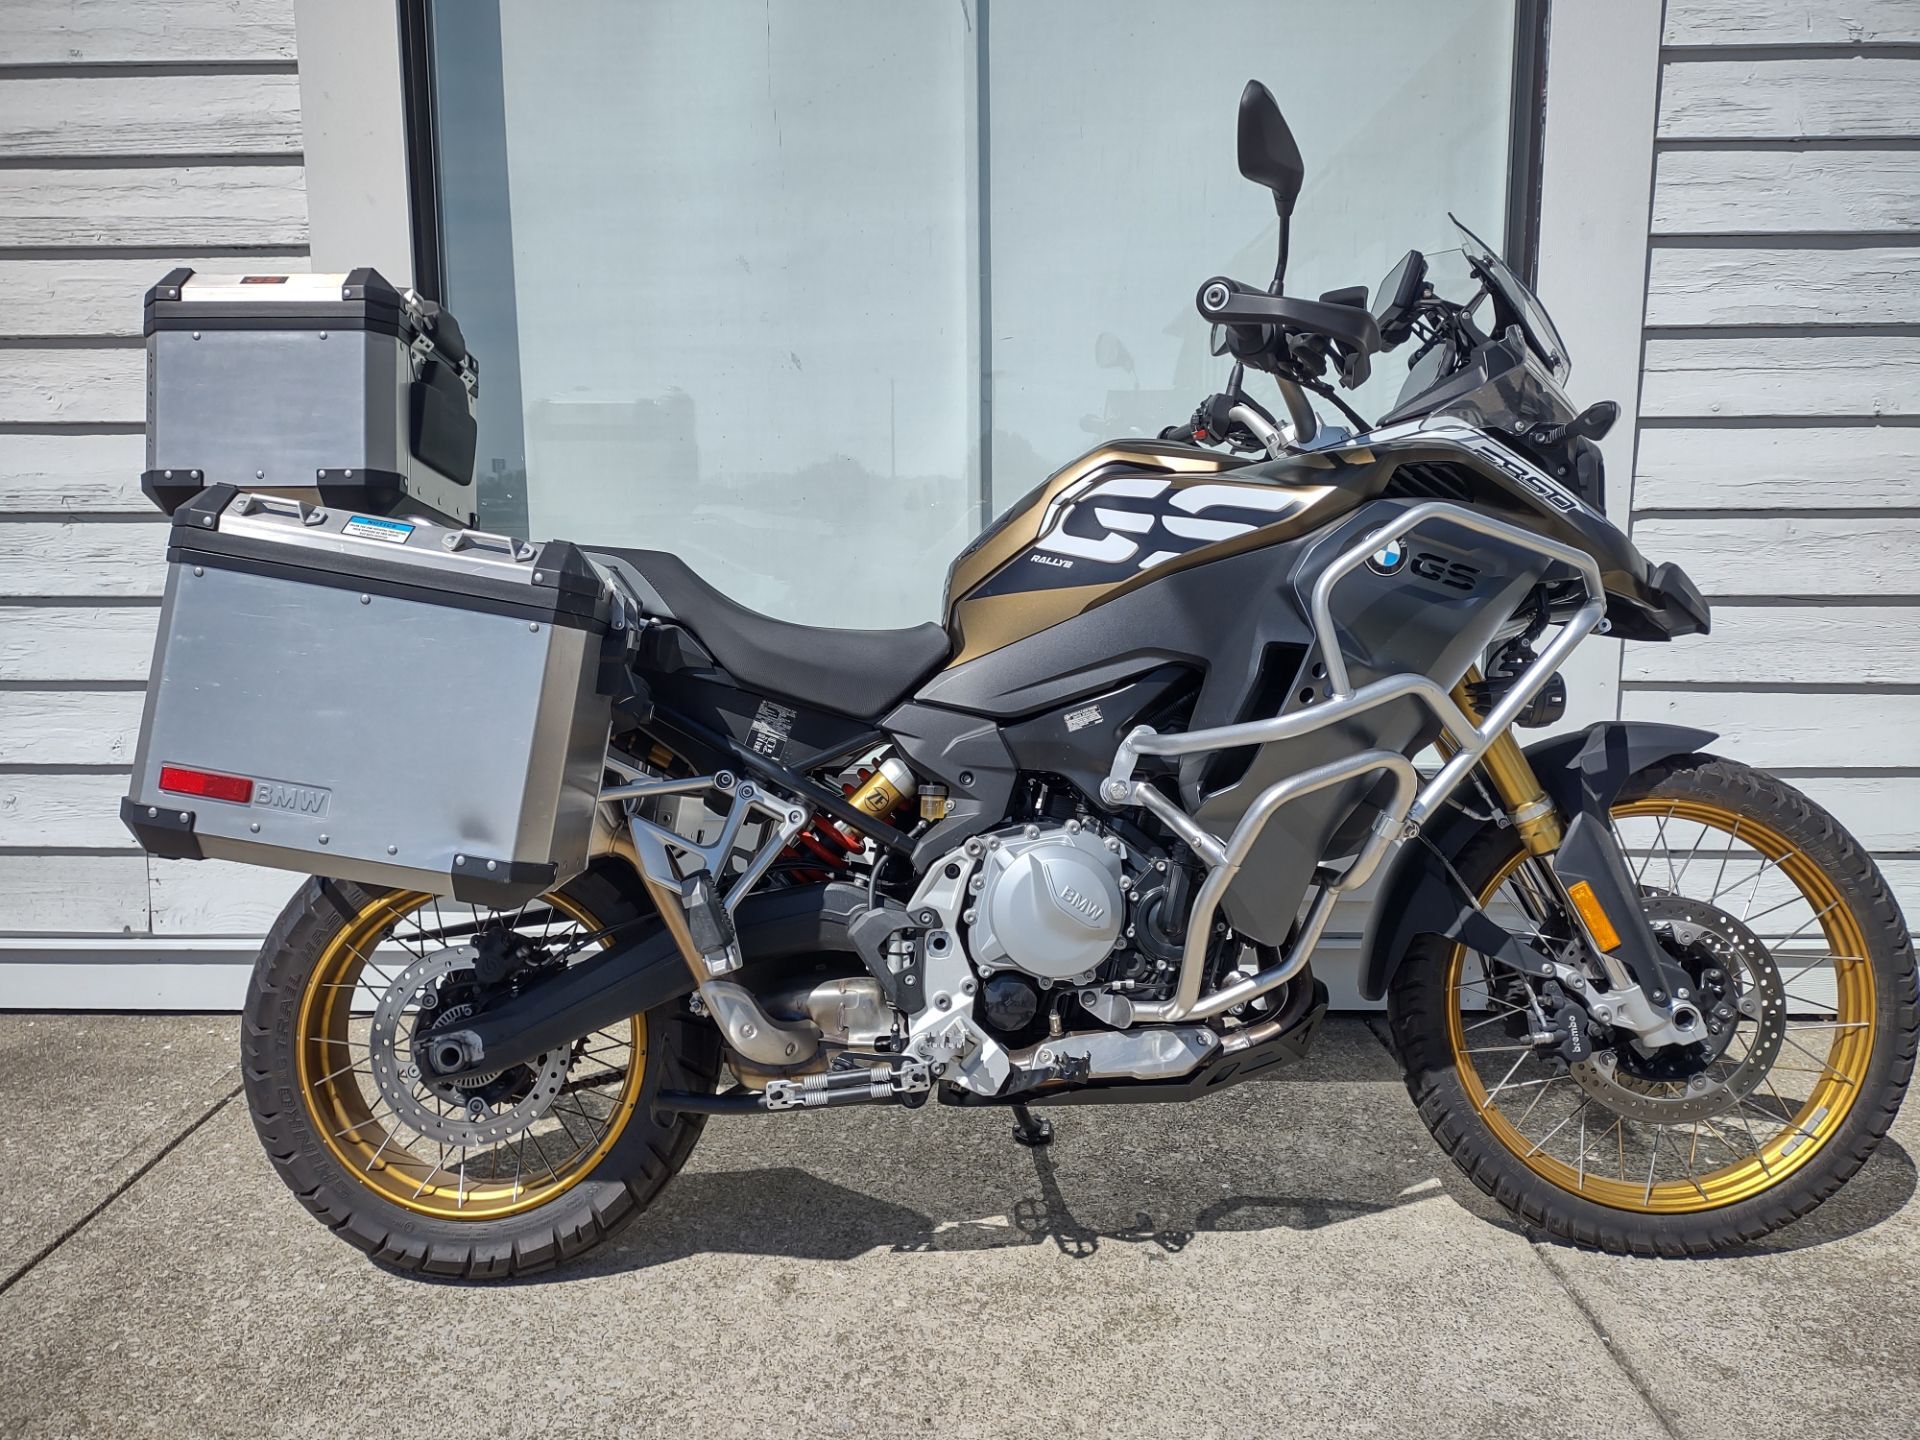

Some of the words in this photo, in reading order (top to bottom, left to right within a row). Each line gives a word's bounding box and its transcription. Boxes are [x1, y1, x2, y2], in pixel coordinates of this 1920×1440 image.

[1030, 554, 1074, 568] RALLYE
[1410, 553, 1481, 590] GS
[254, 784, 326, 813] BMW
[1060, 885, 1105, 921] BMW
[1568, 1015, 1581, 1052] brembo
